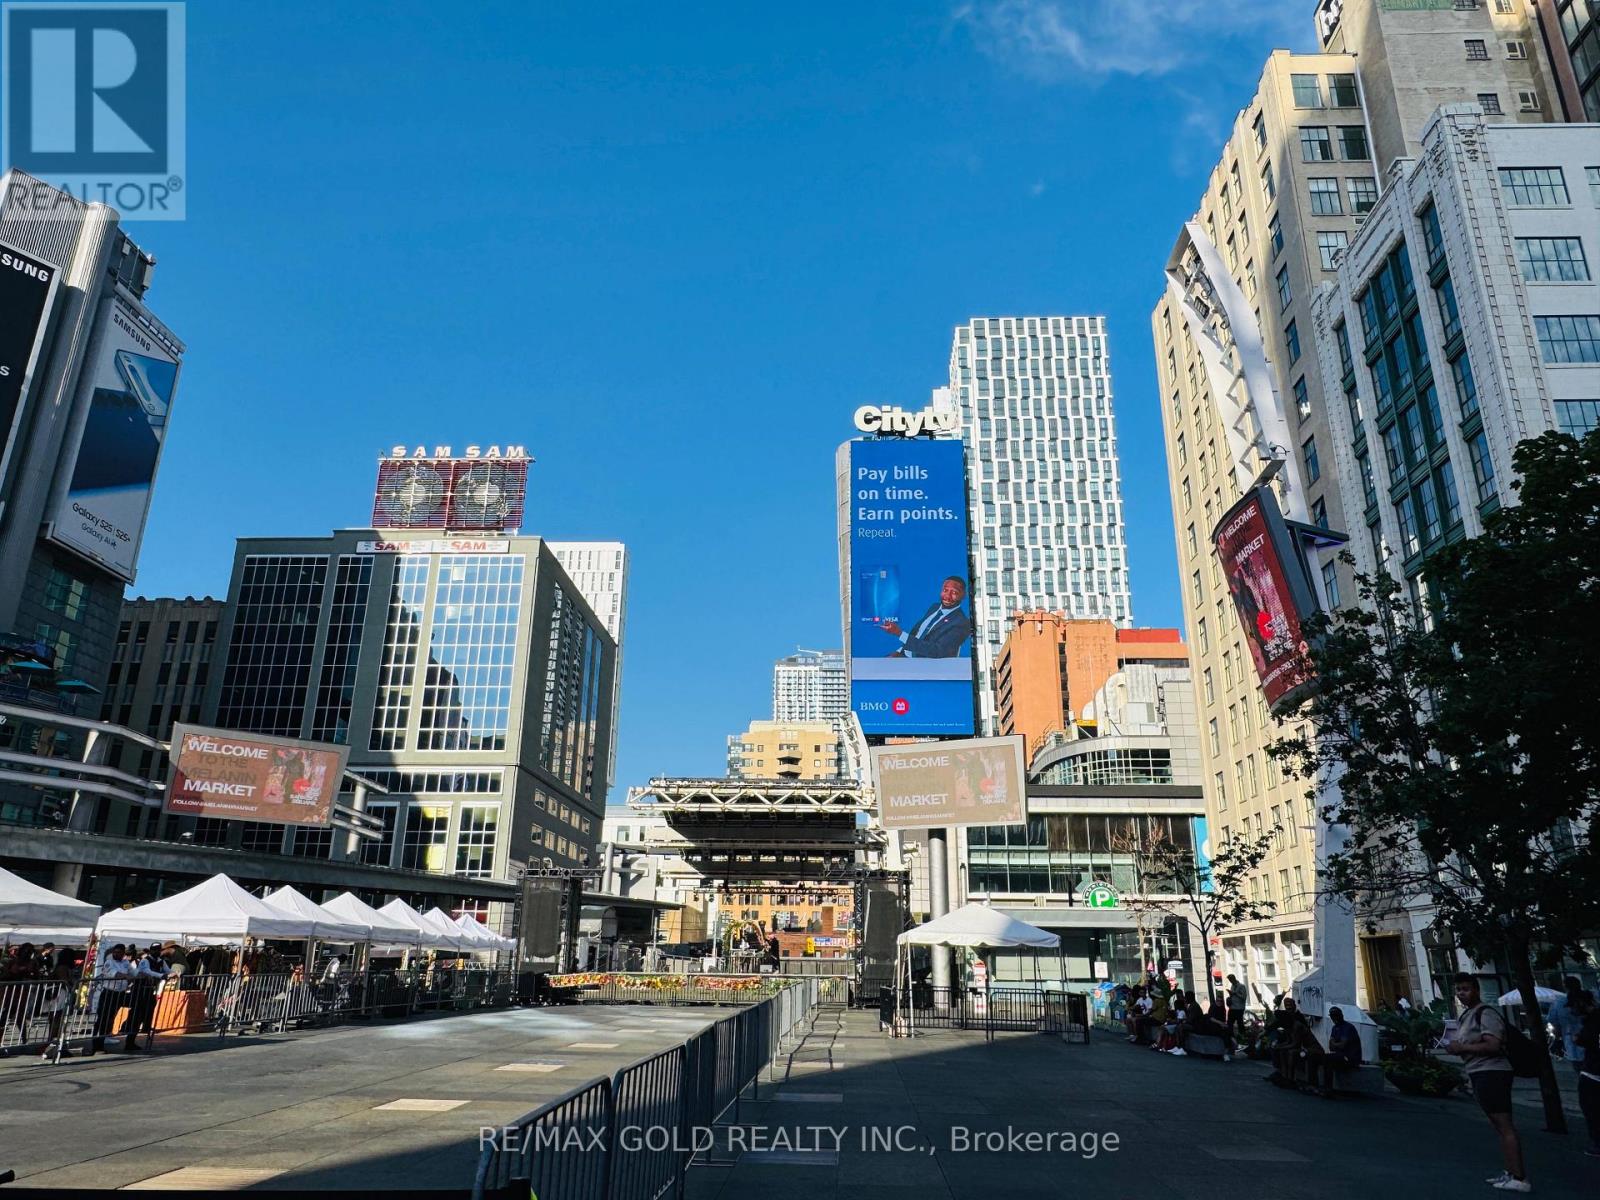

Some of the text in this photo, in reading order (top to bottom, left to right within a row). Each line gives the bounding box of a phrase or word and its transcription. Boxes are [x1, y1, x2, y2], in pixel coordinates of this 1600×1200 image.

[0, 252, 49, 282] SUNG
[113, 313, 151, 351] SAMSUNG
[854, 405, 956, 437] Citytv
[392, 446, 525, 458] SAM SAM
[858, 466, 928, 483] Pay bills
[858, 486, 928, 500] on time.
[72, 502, 100, 526] Galaxy
[100, 519, 113, 533] S25
[858, 506, 958, 523] Earn points.
[1225, 505, 1257, 541] WELCOME
[81, 522, 103, 543] Galaxy
[858, 527, 897, 539] Repeat.
[375, 541, 410, 551] SAM
[451, 541, 487, 551] SAM
[1235, 533, 1265, 566] MARKET
[860, 702, 889, 711] BMO
[188, 739, 269, 760] WELCOME
[199, 754, 248, 768] TO THE
[884, 755, 950, 770] WELCOME
[184, 779, 256, 797] MARKET
[890, 793, 948, 807] MARKET
[1095, 890, 1110, 906] P
